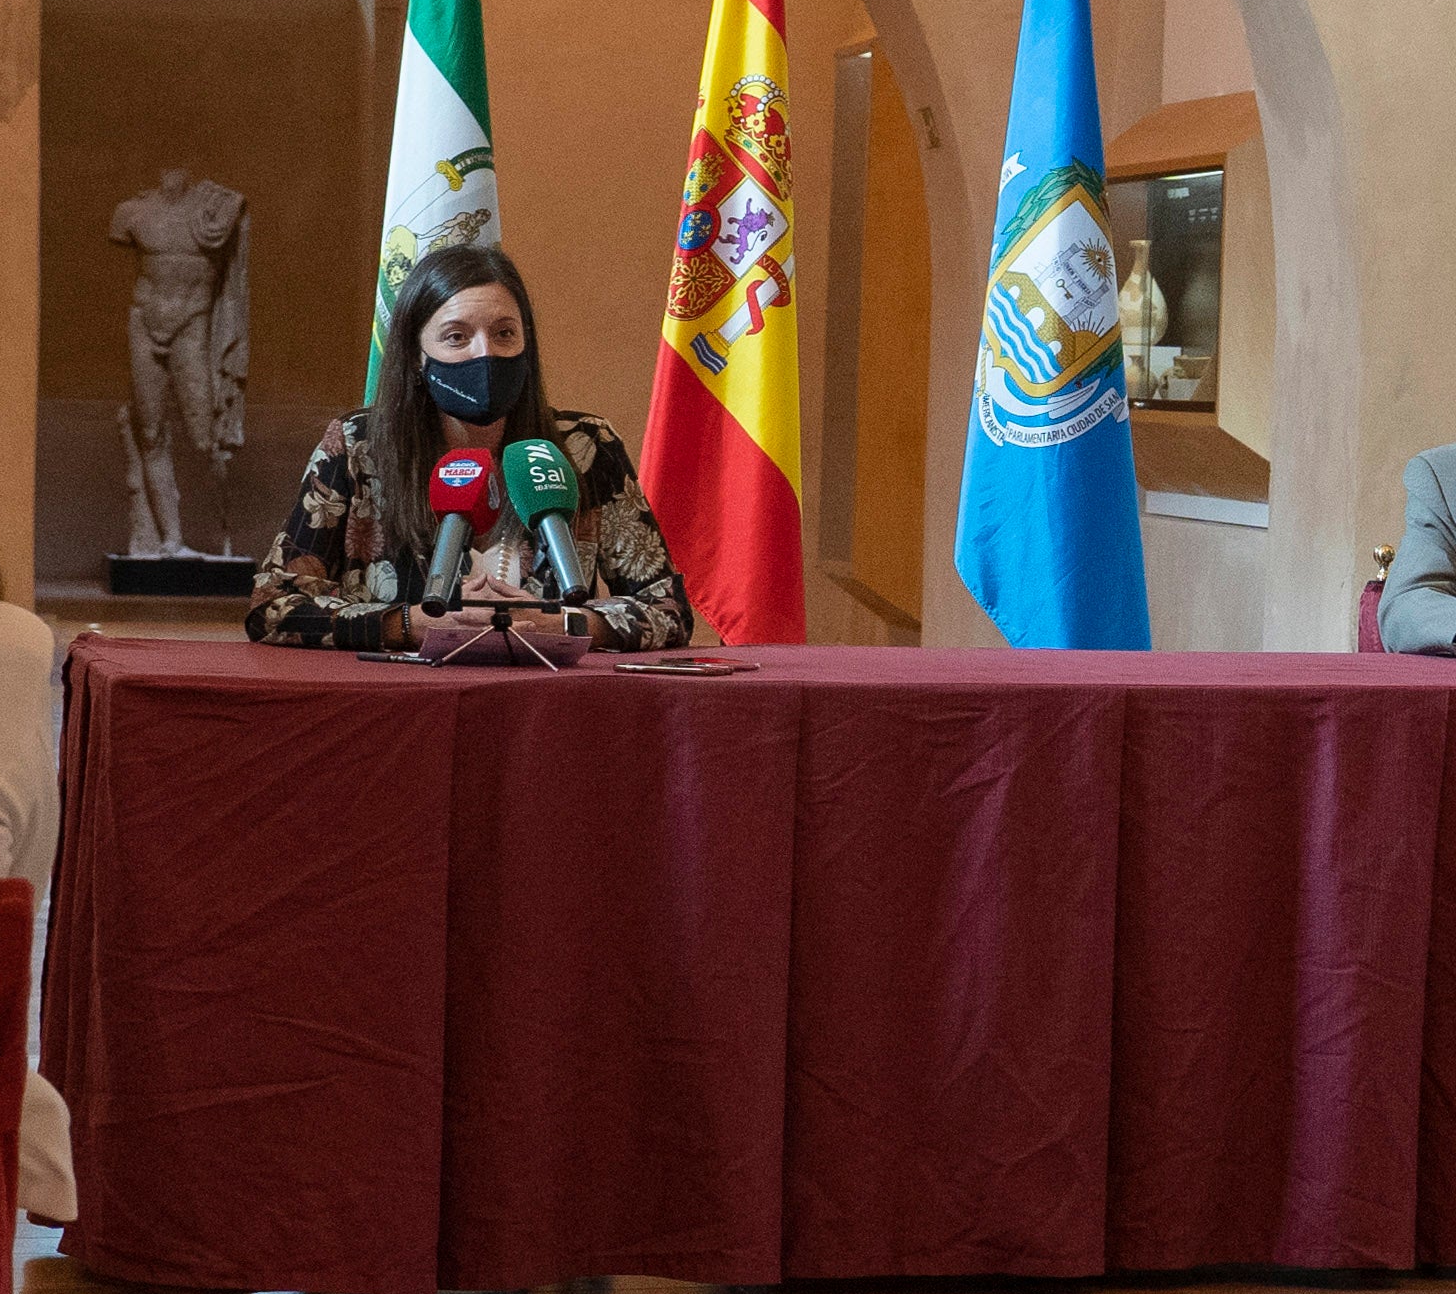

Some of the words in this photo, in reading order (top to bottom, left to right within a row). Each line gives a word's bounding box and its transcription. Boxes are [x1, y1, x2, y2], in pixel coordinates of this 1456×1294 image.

[762, 257, 790, 300] VLTRA
[1066, 411, 1096, 436] CIUDAD
[1094, 404, 1107, 419] DE
[1104, 392, 1120, 411] SAN
[444, 468, 476, 476] MARCA
[529, 466, 566, 483] Sal
